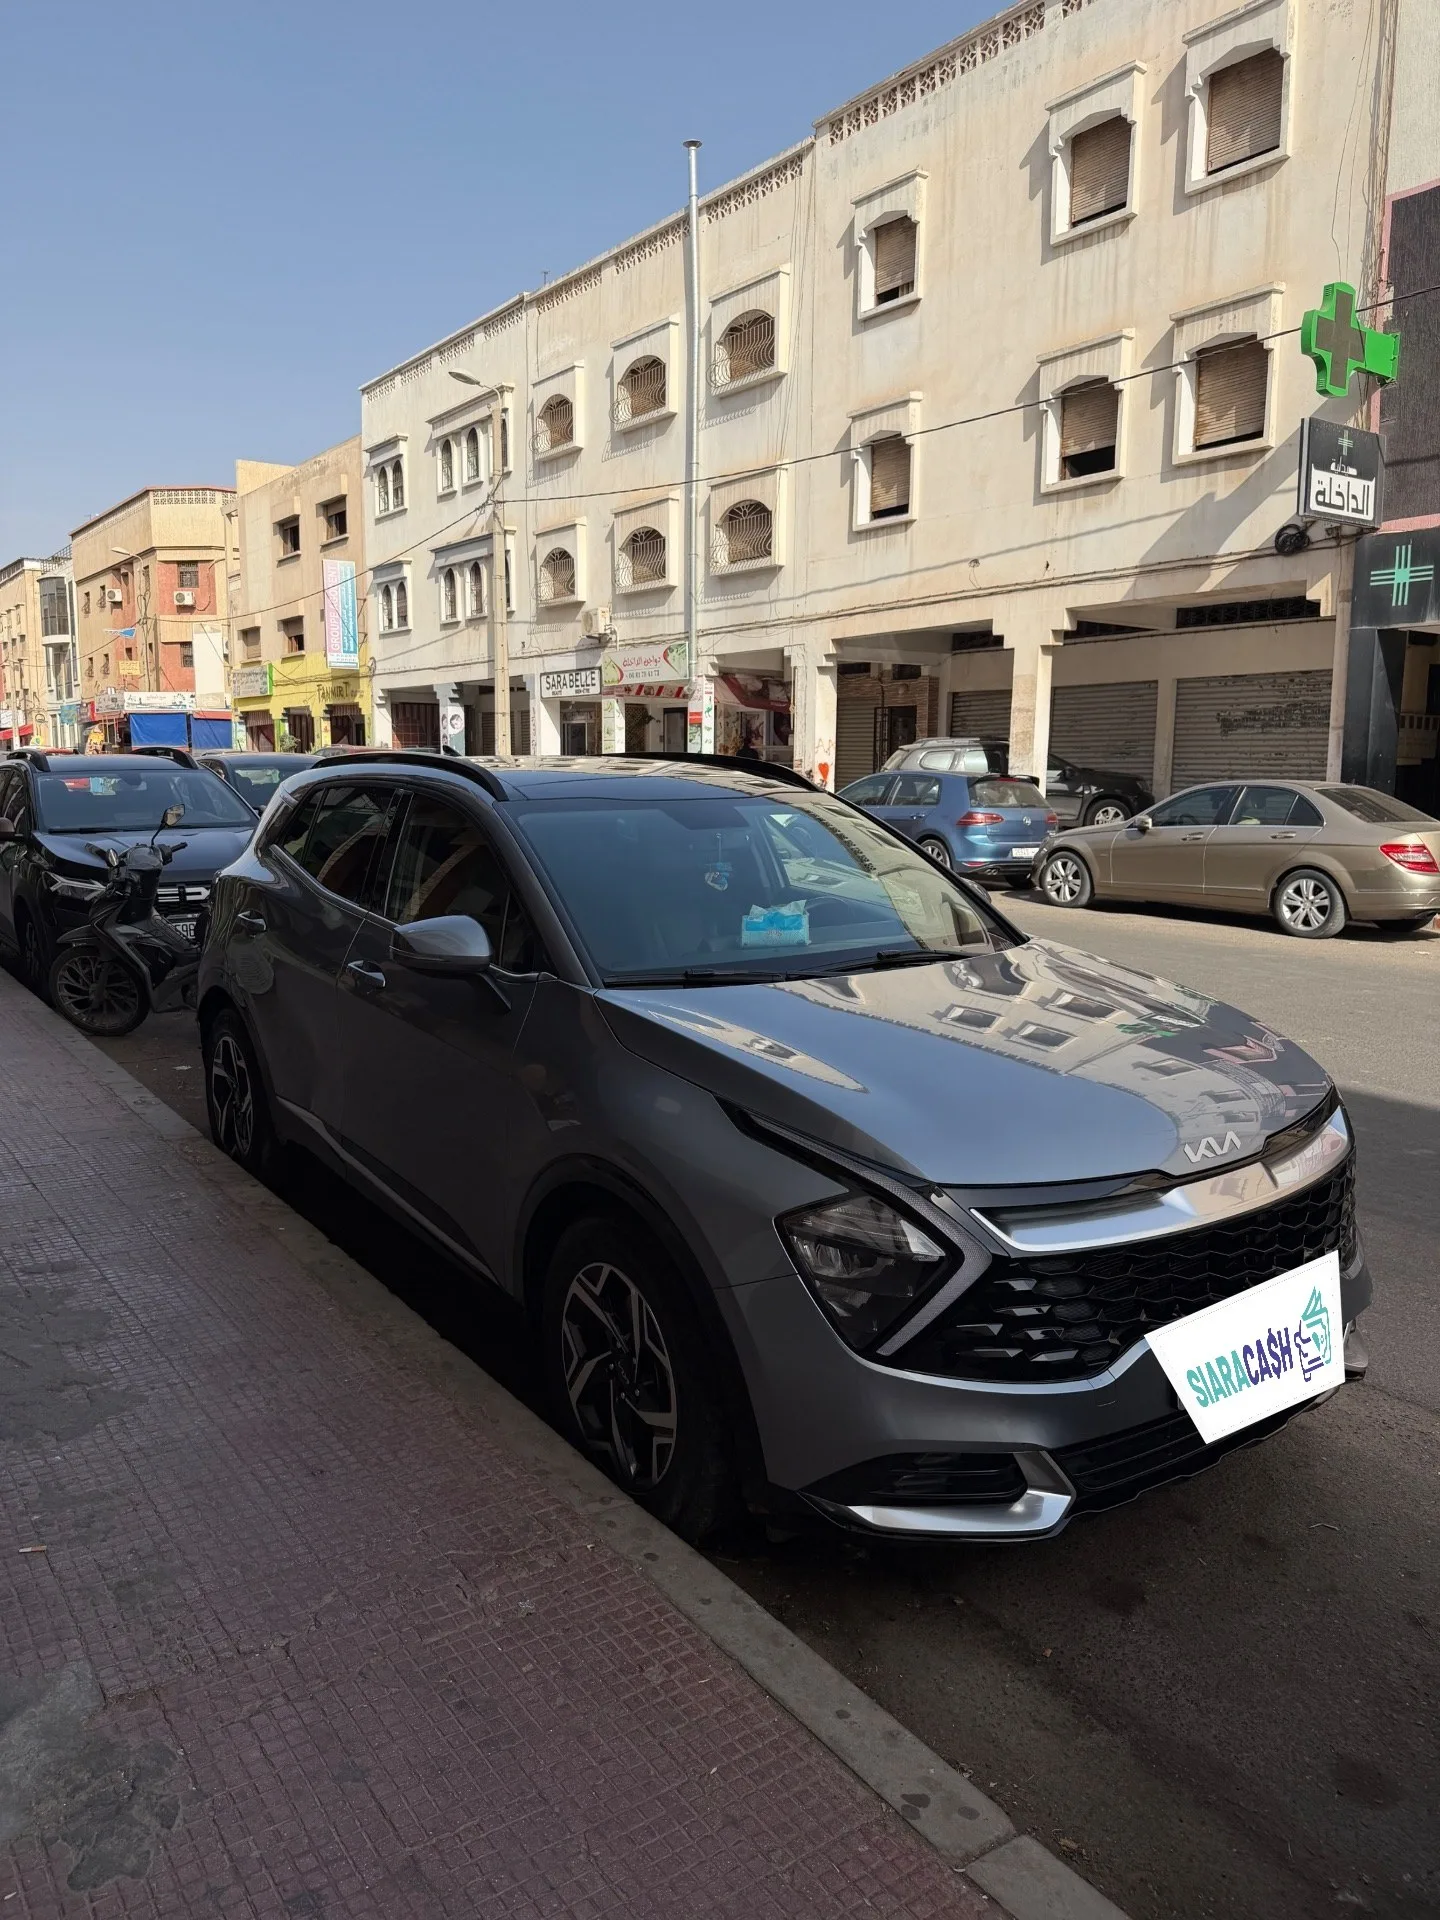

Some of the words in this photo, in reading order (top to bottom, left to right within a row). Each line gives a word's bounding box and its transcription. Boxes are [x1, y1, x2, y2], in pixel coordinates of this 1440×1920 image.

[1330, 456, 1357, 477] صيدلية
[1315, 477, 1370, 516] الداخلة
[545, 674, 568, 690] SARA
[569, 671, 597, 688] BELLE
